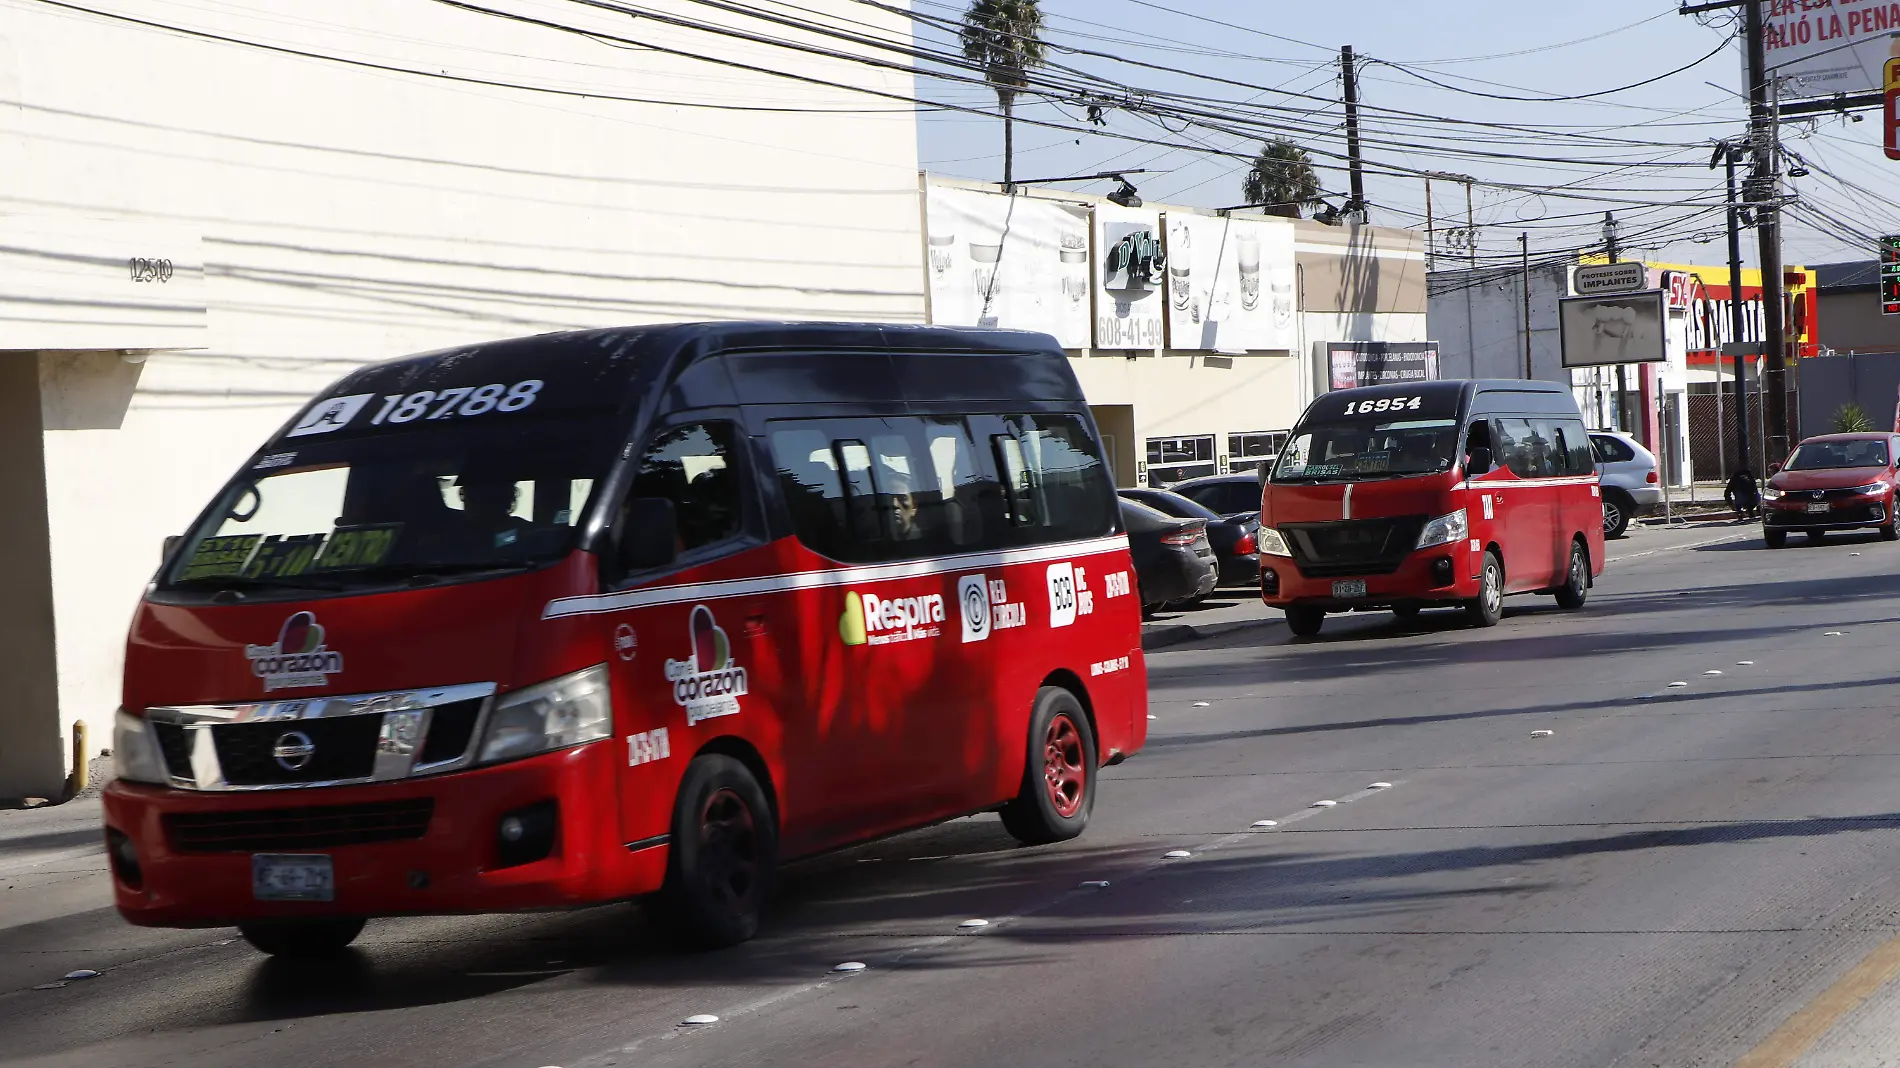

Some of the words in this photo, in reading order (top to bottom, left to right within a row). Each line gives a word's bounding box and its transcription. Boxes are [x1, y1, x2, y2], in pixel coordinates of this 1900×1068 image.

[1761, 14, 1811, 50] ALIÓ
[1817, 14, 1843, 41] LA
[1847, 3, 1900, 36] PENA
[1583, 277, 1637, 288] IMPLANTES
[1099, 317, 1162, 346] 608-41-99
[370, 379, 544, 425] 18788
[1343, 396, 1421, 415] 16954
[1305, 468, 1338, 476] BRISAS
[862, 593, 946, 640] Respira
[253, 645, 342, 676] corazón
[675, 658, 747, 704] corazón
